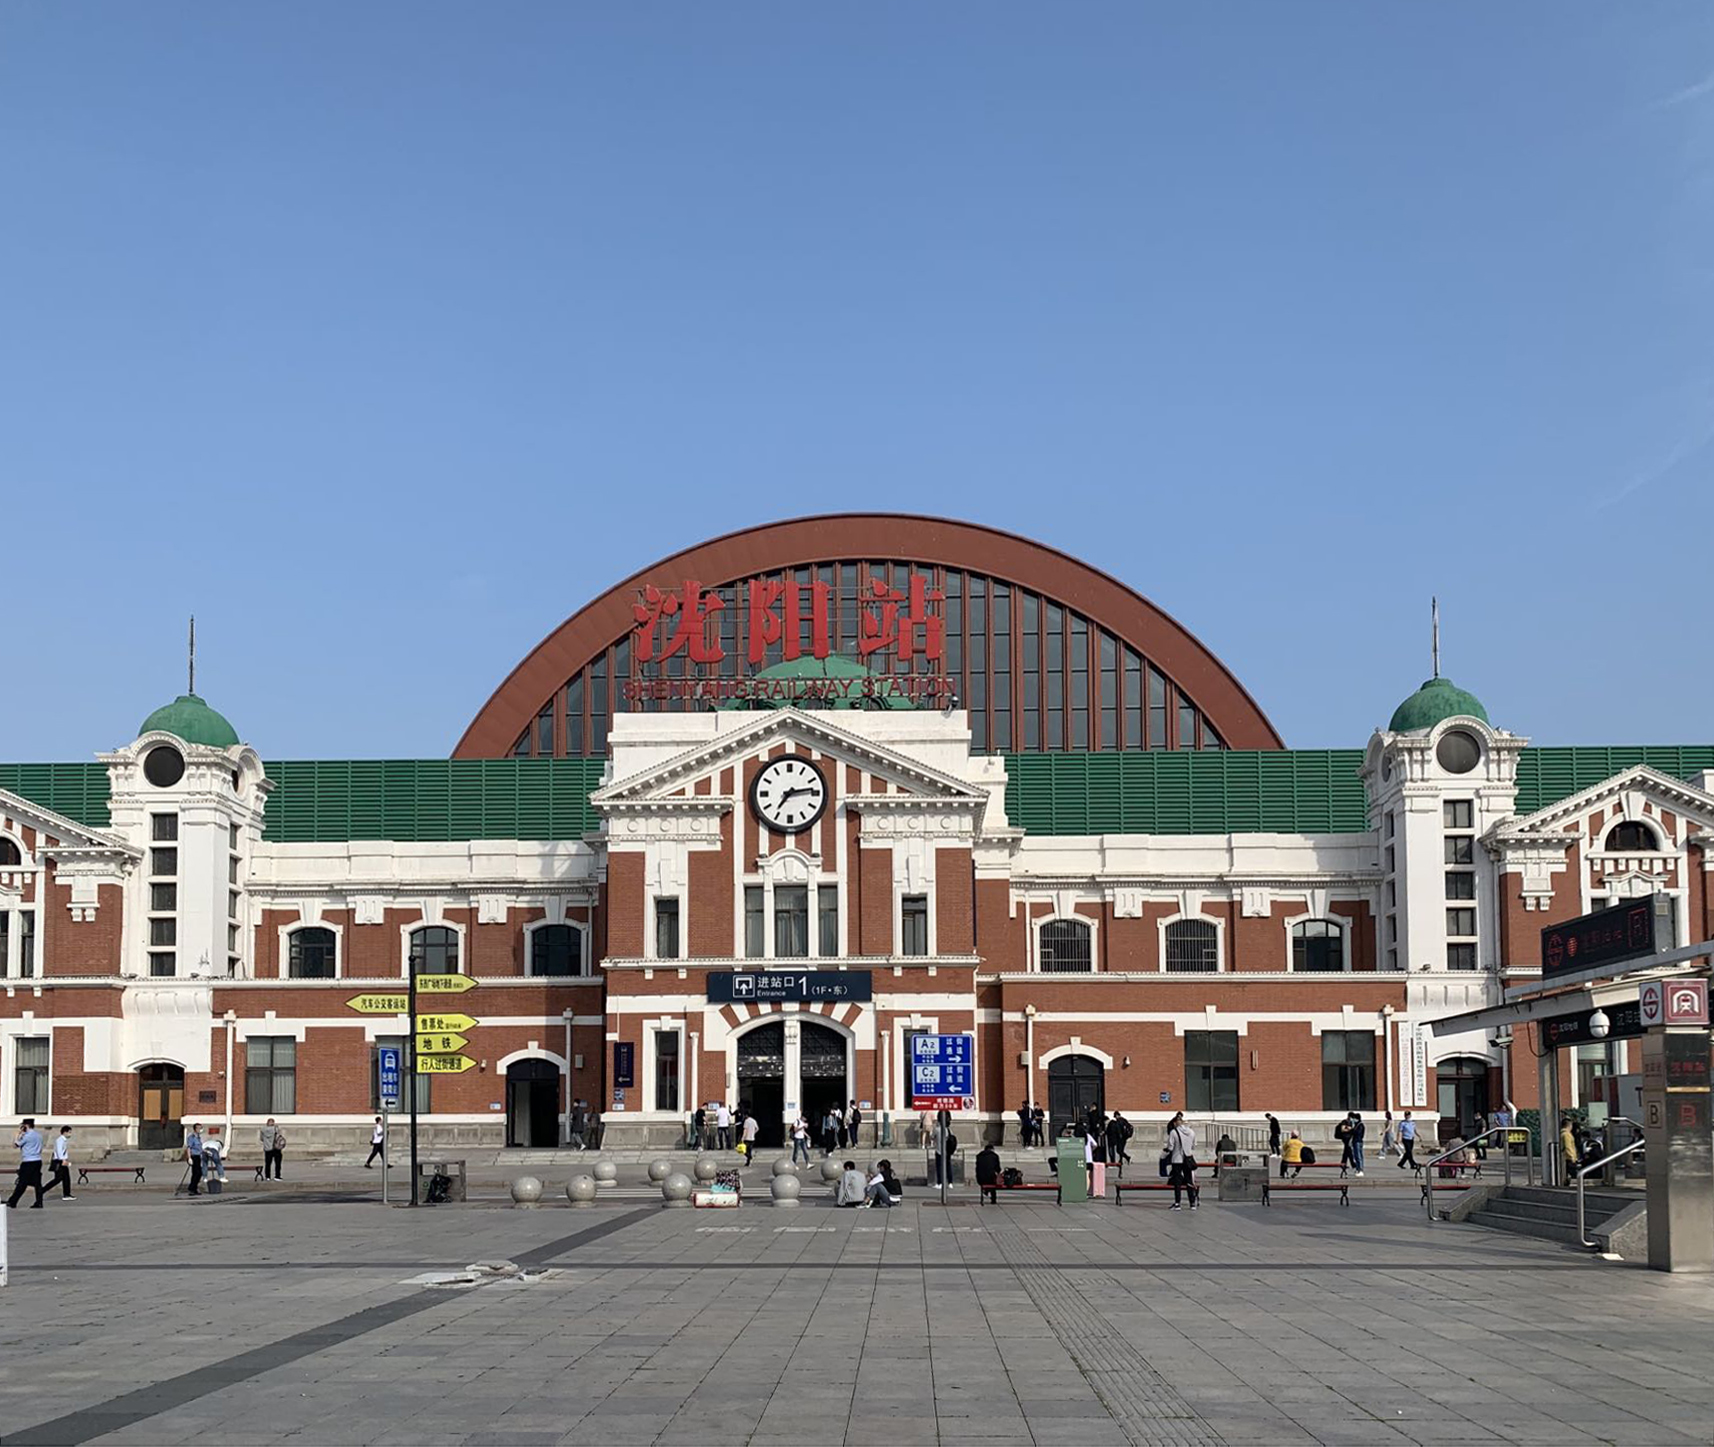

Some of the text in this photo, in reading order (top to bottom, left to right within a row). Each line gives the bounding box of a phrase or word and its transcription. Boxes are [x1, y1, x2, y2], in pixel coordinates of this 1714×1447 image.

[632, 574, 947, 664] 沈阳站
[622, 676, 957, 699] SHENYANG RAILWAY STATION
[757, 976, 795, 988] 进站口
[798, 976, 807, 996] 1
[361, 998, 406, 1009] 汽车公交客运站
[421, 1017, 444, 1030] 售票处
[423, 1036, 452, 1051] 地铁
[921, 1039, 935, 1049] A2
[421, 1058, 462, 1071] 行人过街通道
[921, 1067, 935, 1077] C2
